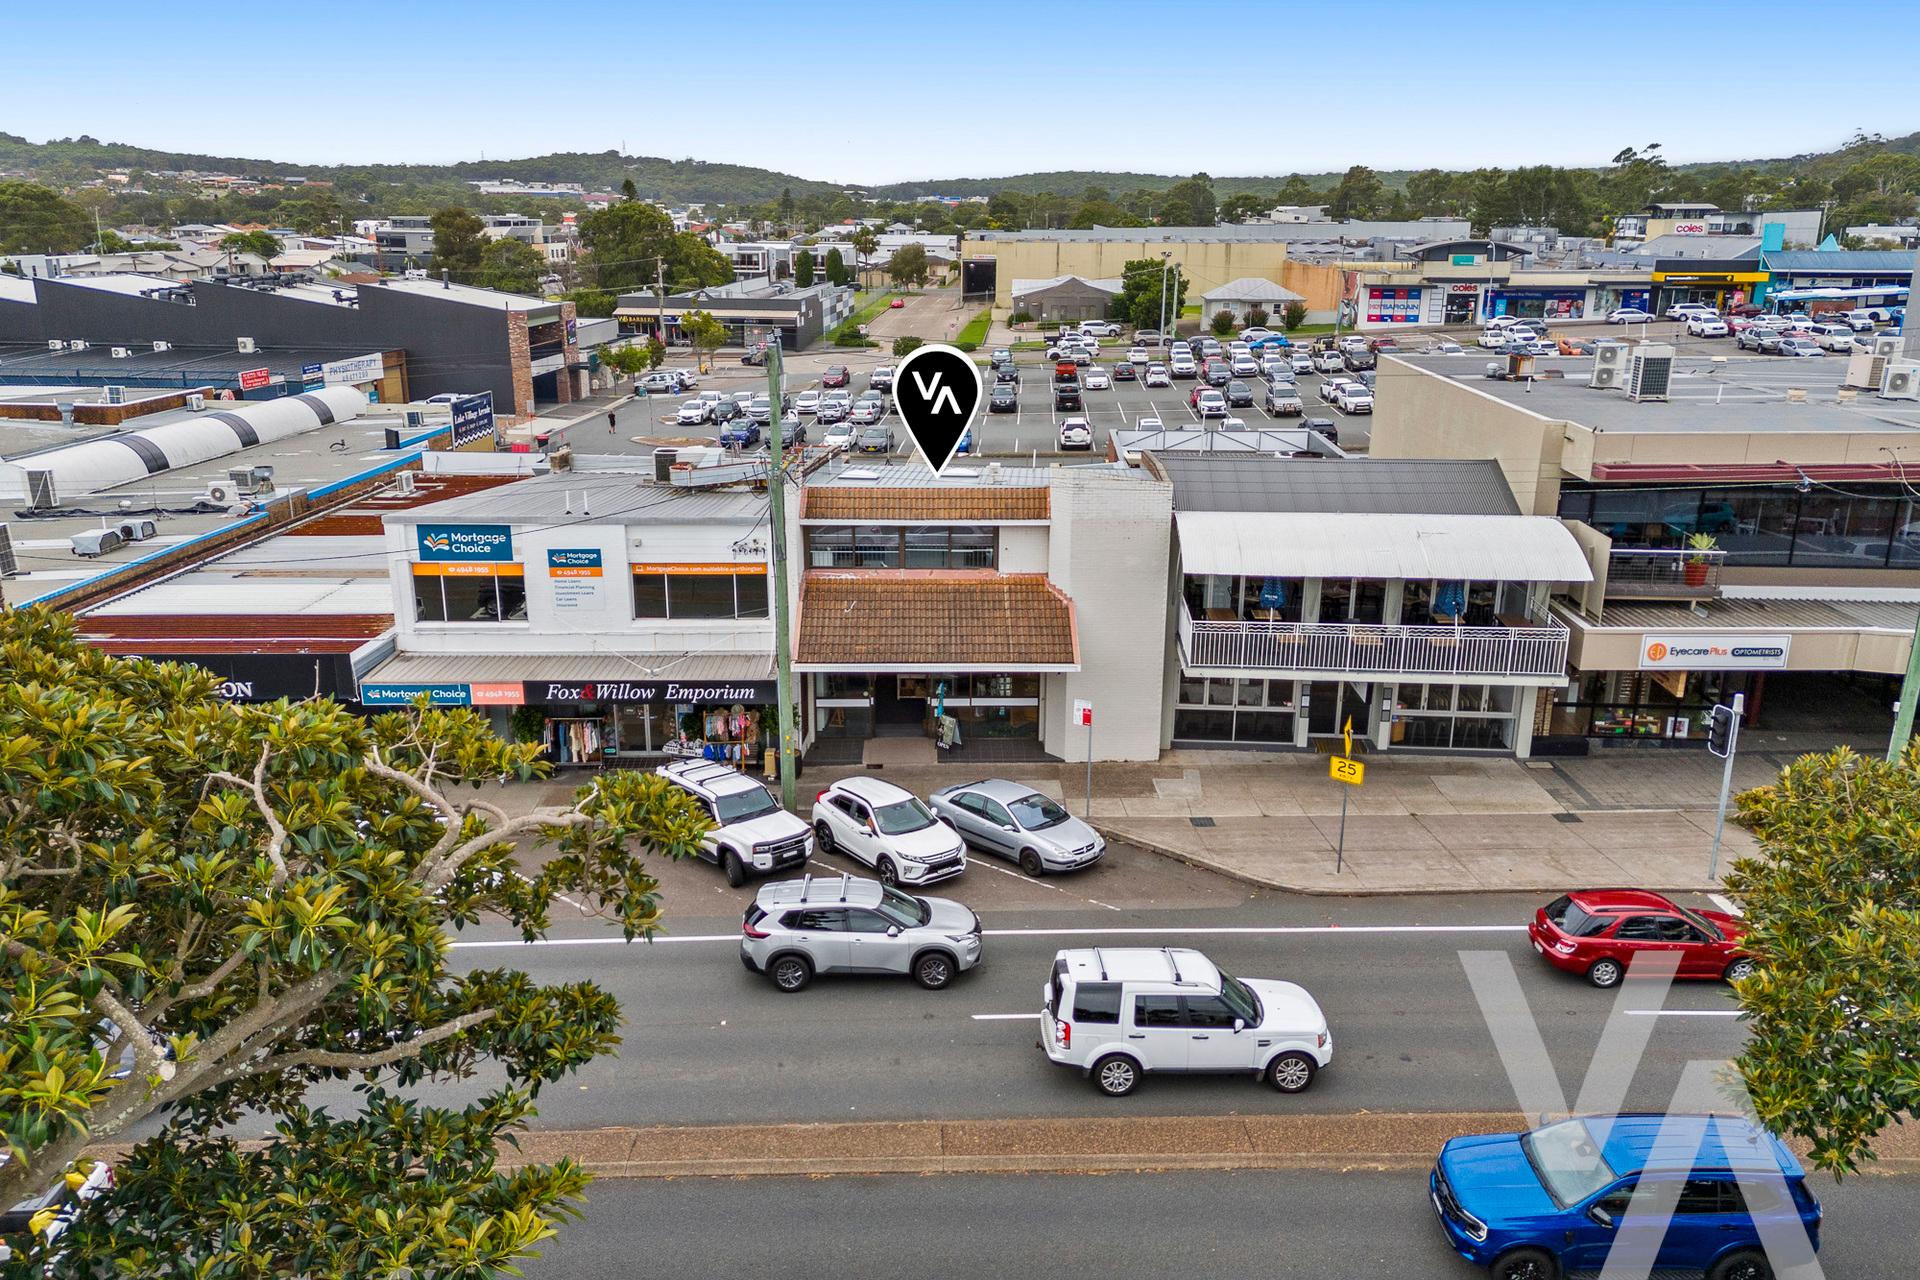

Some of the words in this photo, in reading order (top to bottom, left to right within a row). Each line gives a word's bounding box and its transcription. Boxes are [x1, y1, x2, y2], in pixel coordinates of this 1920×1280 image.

[1676, 223, 1703, 233] coles
[1452, 283, 1478, 292] coles
[329, 359, 376, 376] PHYSIOTHERAPY
[451, 532, 506, 544] Mortgage
[451, 543, 491, 553] Choice
[567, 552, 597, 560] Mortgage
[474, 566, 489, 574] 1955
[1670, 647, 1709, 656] Eyecare
[1710, 646, 1727, 656] Plus
[1733, 648, 1782, 656] OPTOMETRISTS
[432, 689, 466, 698] Choice
[665, 684, 755, 703] Emporium
[1337, 761, 1357, 776] 25
